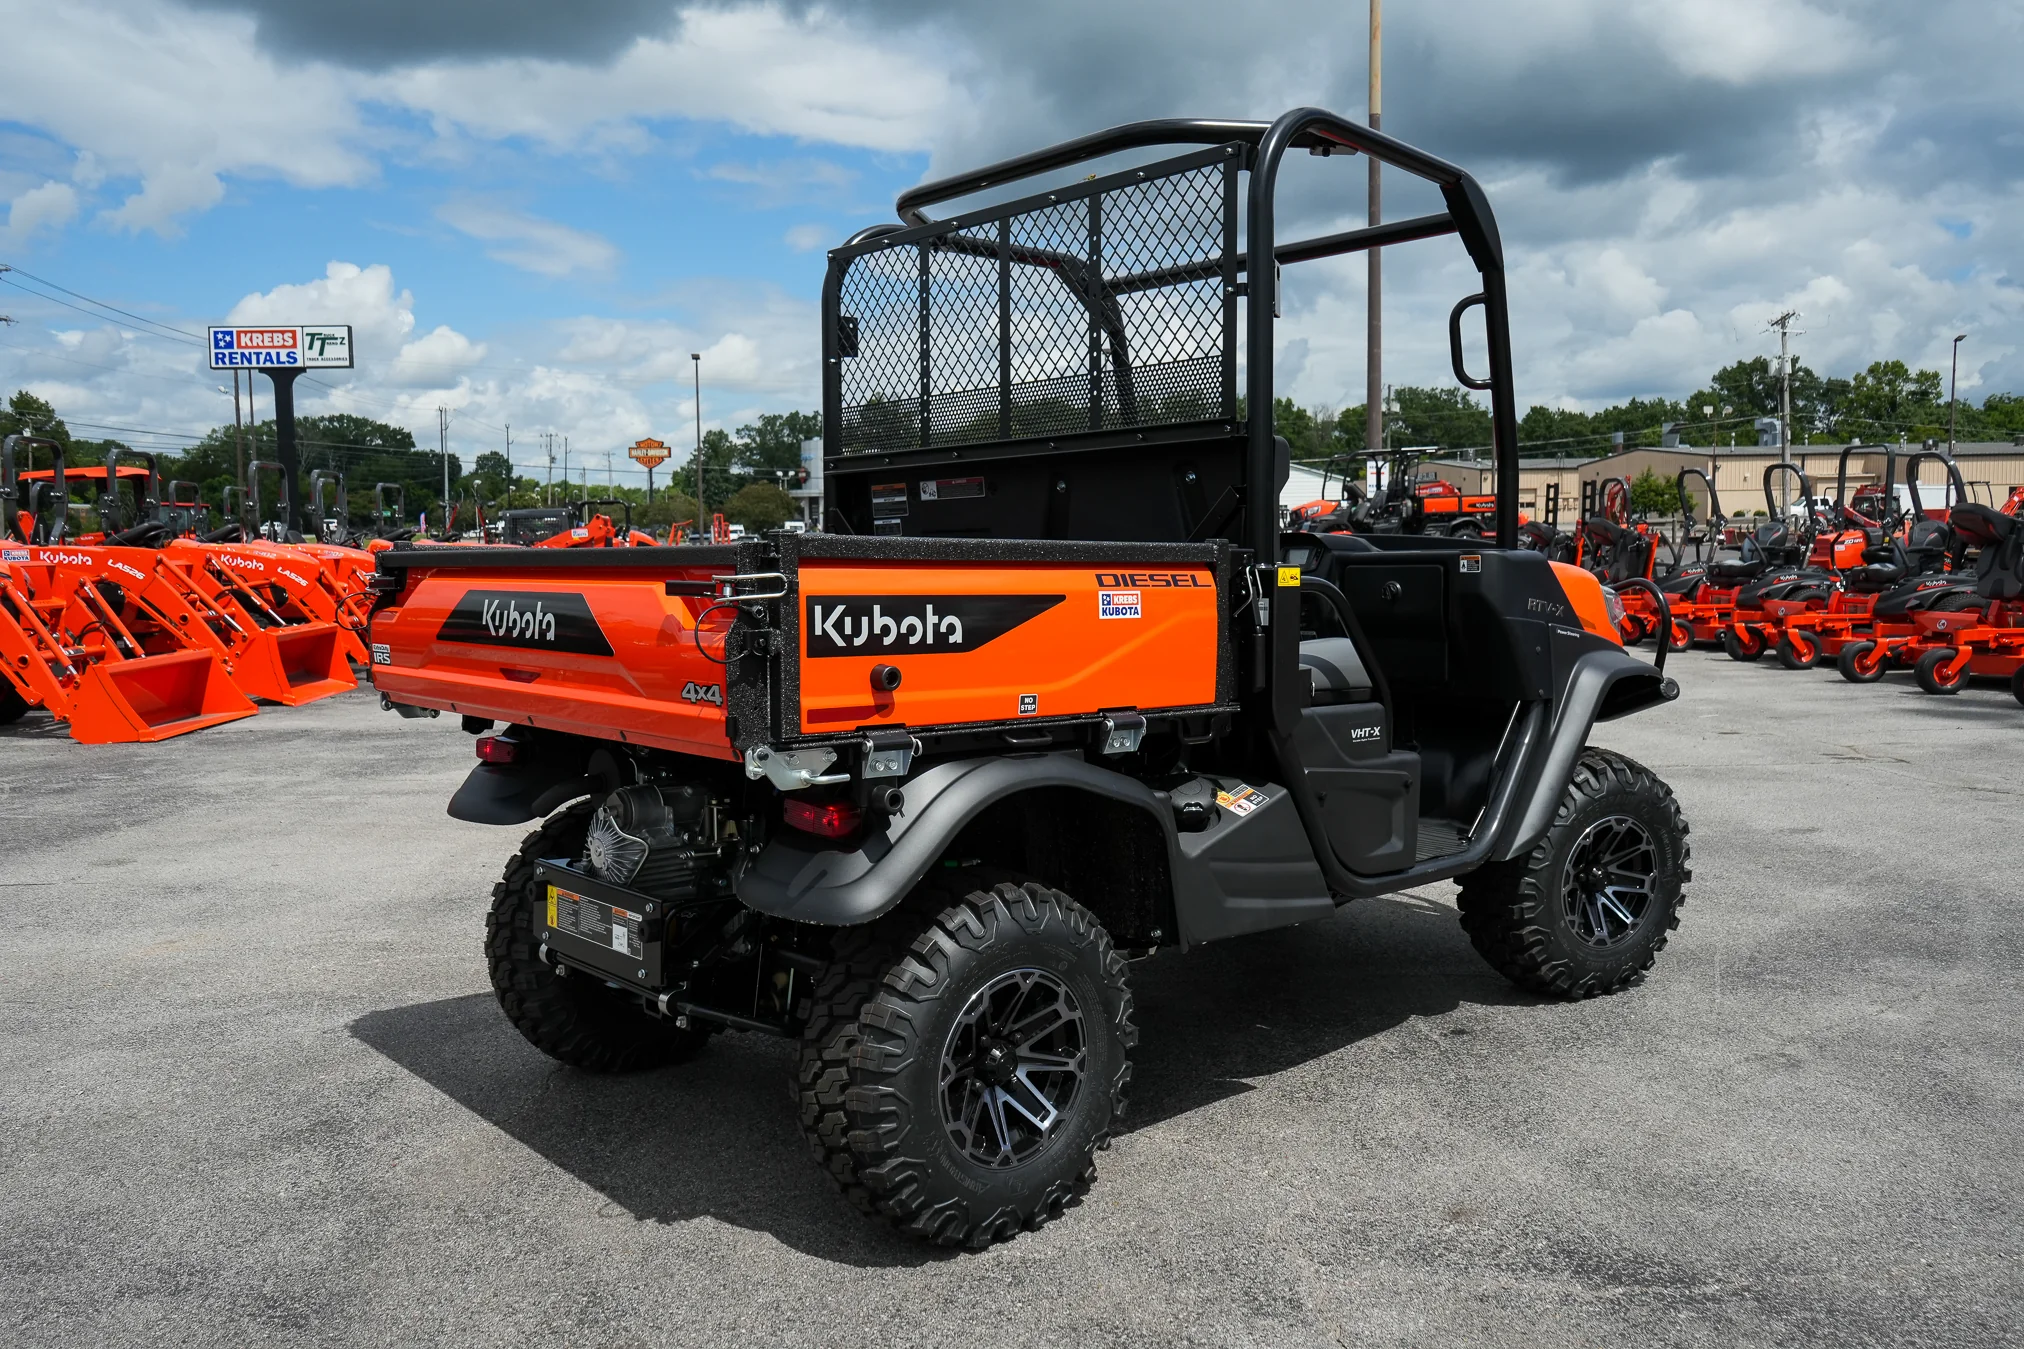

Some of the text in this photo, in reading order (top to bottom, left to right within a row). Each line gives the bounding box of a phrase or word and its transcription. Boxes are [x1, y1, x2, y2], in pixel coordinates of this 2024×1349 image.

[240, 332, 293, 347] KREBS
[214, 351, 298, 366] RENTALS
[40, 551, 92, 565] Kubota
[220, 554, 264, 571] Kubota
[107, 559, 146, 580] LA526
[277, 566, 308, 587] LA526
[1095, 573, 1212, 588] DIESEL
[1113, 595, 1138, 604] KREBS
[1527, 597, 1564, 617] RTV-X
[1101, 606, 1139, 617] KUBOTA
[482, 599, 556, 640] Kubota
[814, 604, 963, 647] Kubota
[374, 652, 390, 664] IRS
[681, 681, 723, 707] 4x4
[1351, 726, 1381, 738] VHT-X
